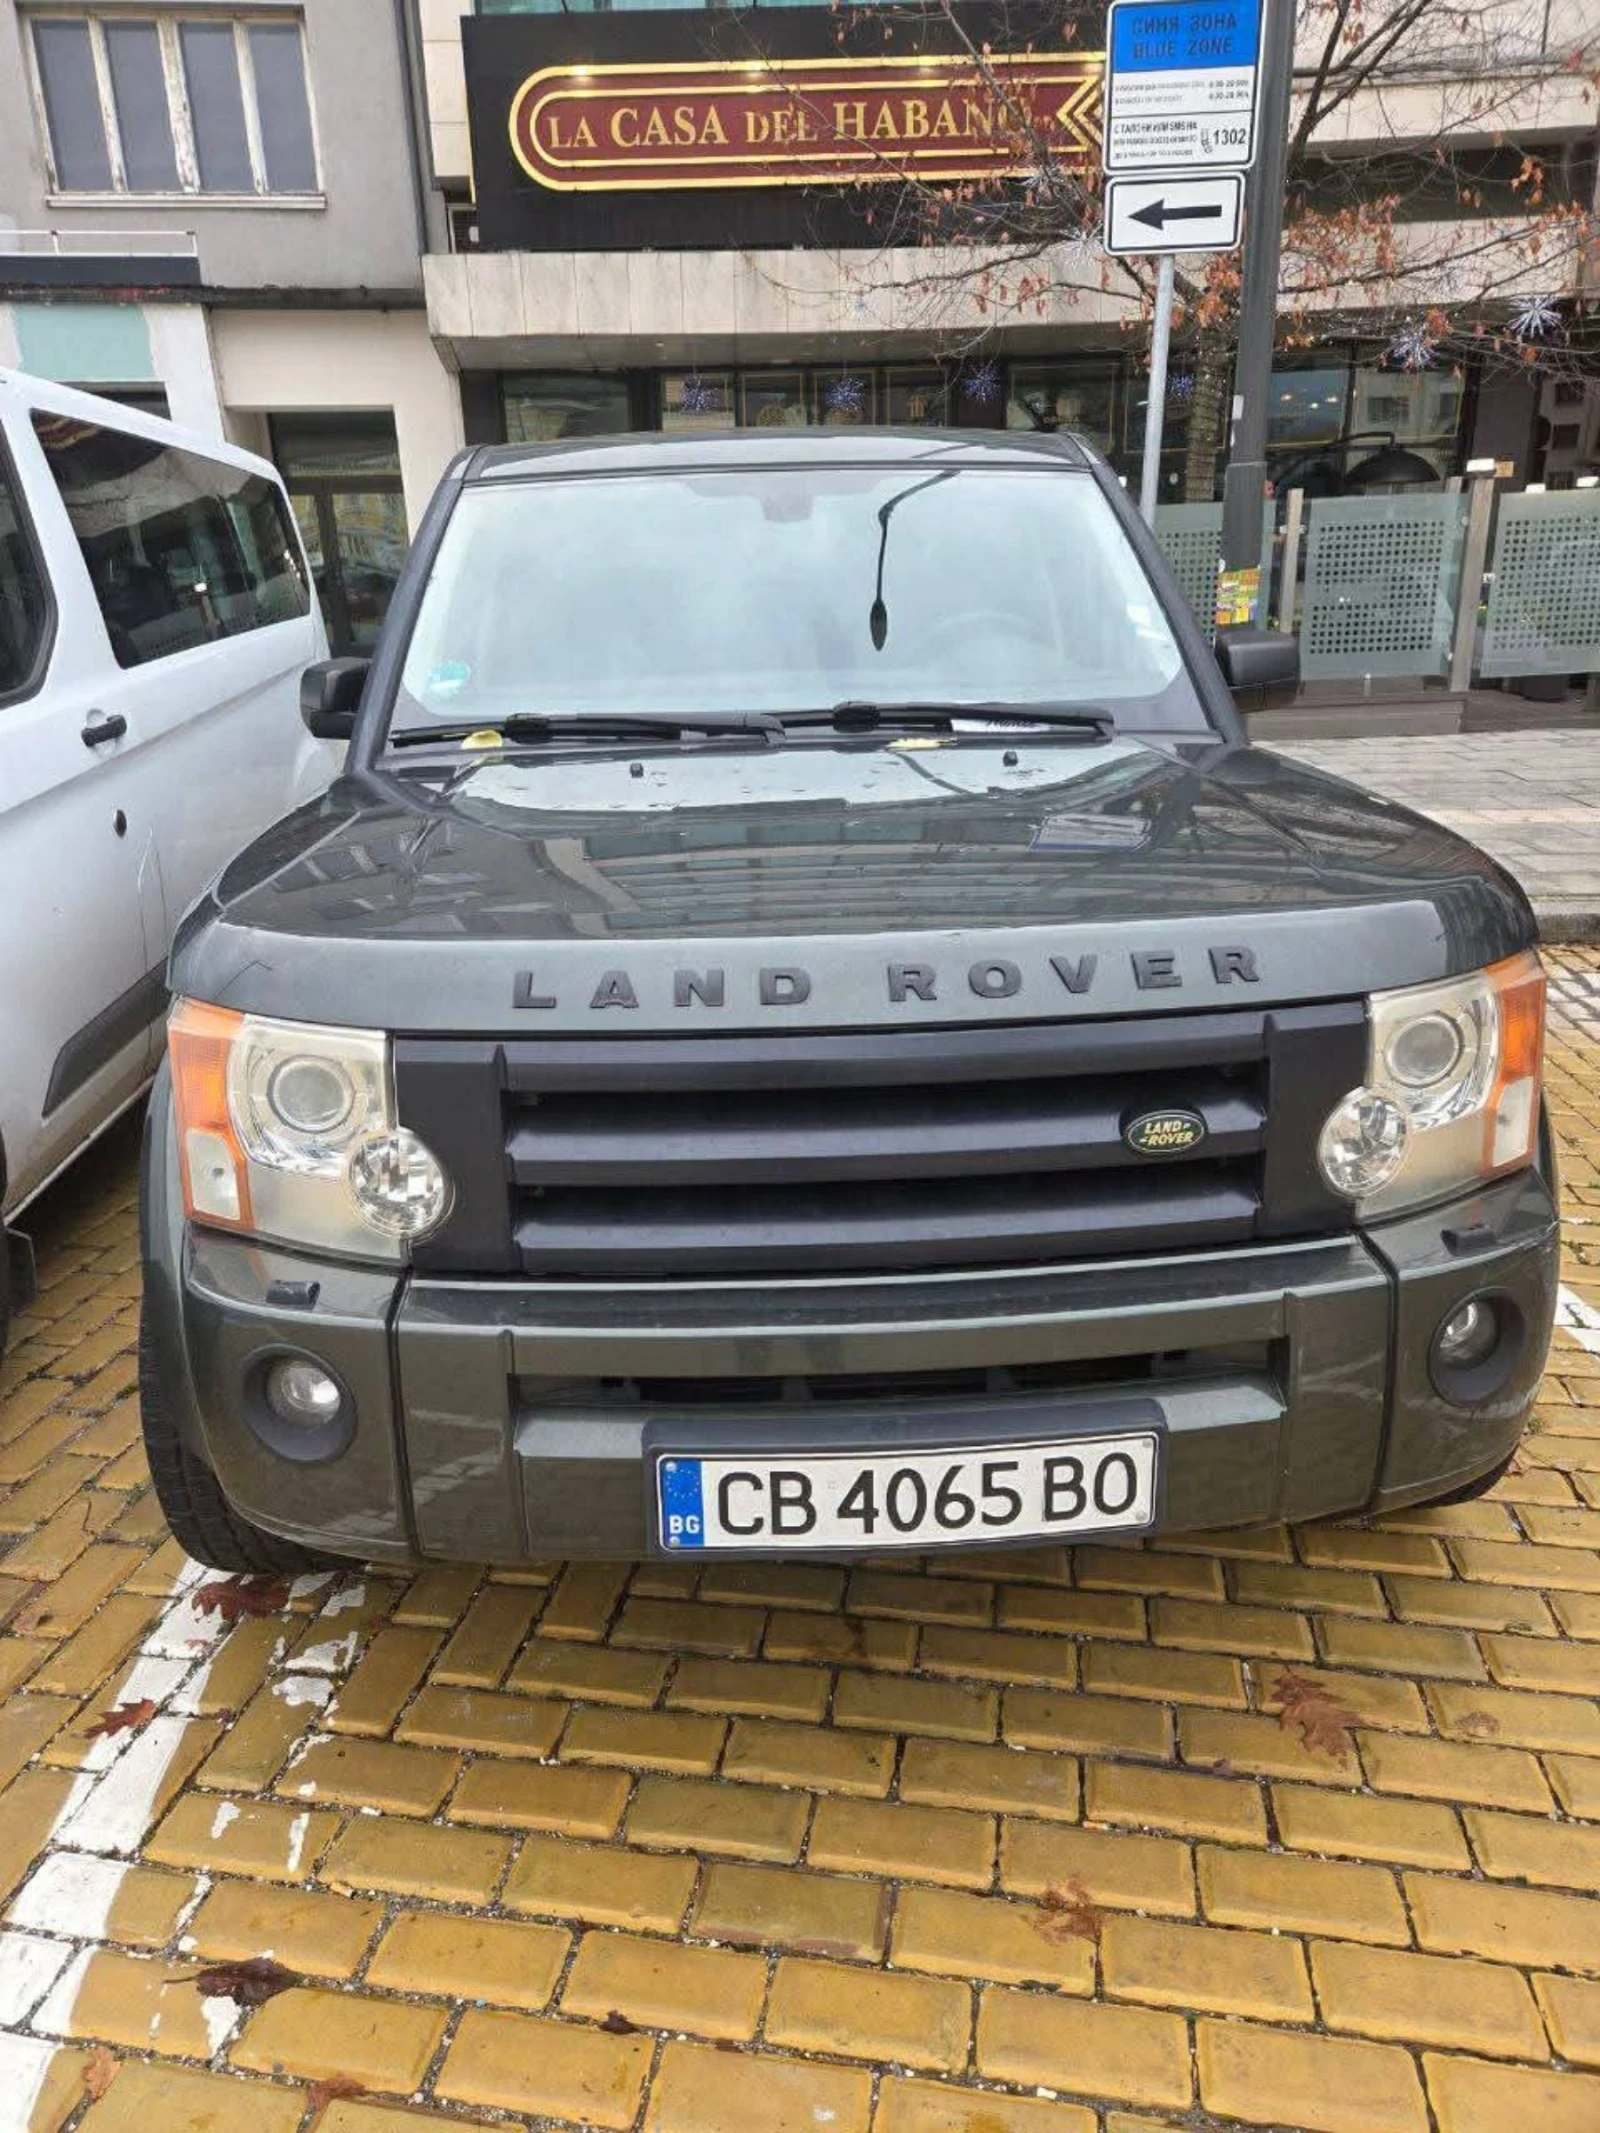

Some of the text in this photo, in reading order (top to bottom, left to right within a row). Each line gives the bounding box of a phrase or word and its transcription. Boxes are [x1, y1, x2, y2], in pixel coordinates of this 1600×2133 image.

[1190, 13, 1237, 31] ЗОНА
[1134, 37, 1232, 58] BLUE ZONE
[549, 116, 597, 148] LA
[611, 104, 729, 148] CASA
[744, 109, 818, 143] DEL
[1214, 127, 1247, 145] 1302
[512, 945, 1260, 1009] LAND ROVER
[717, 1452, 1138, 1536] CB 4065 BO
[668, 1515, 700, 1534] BG
